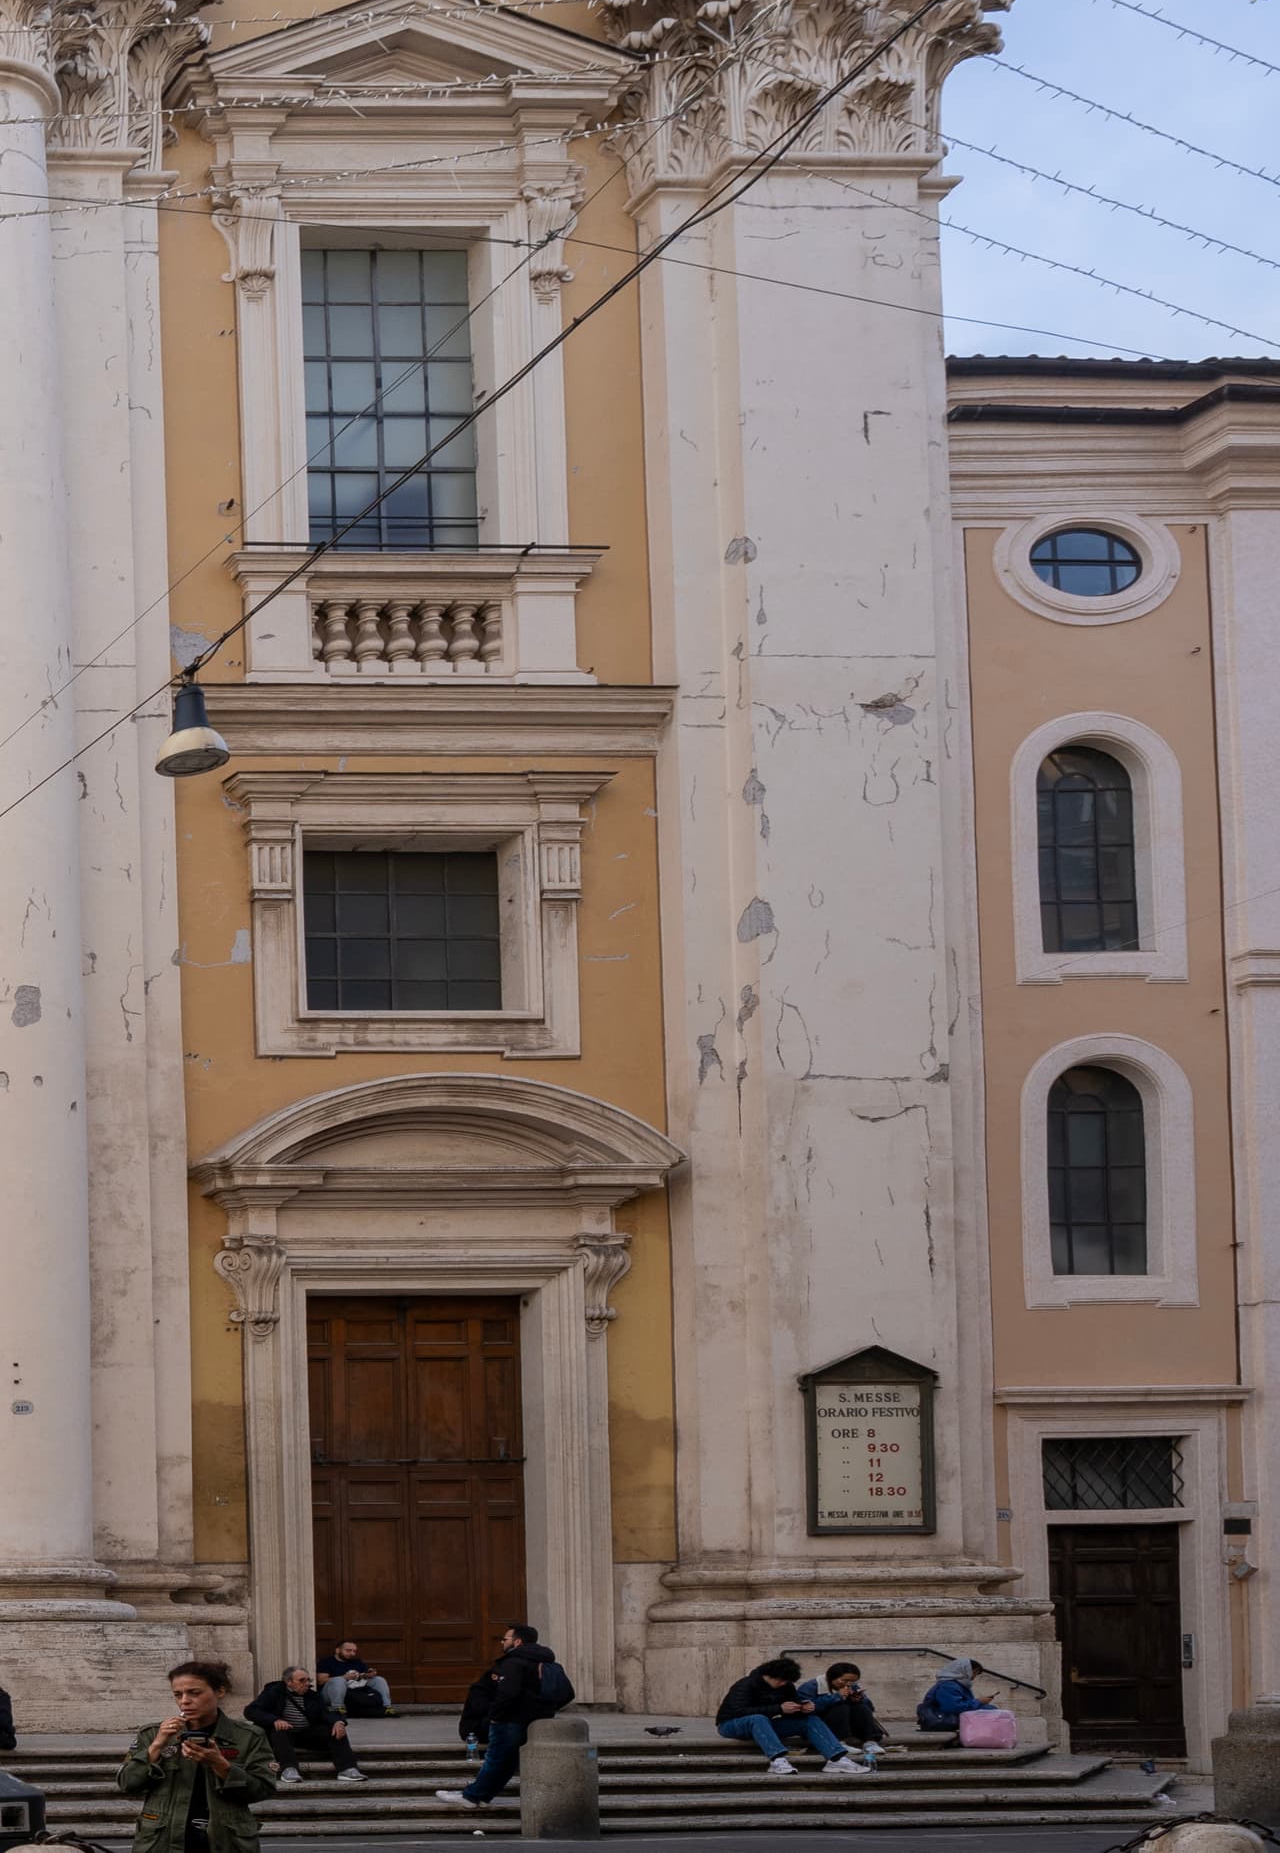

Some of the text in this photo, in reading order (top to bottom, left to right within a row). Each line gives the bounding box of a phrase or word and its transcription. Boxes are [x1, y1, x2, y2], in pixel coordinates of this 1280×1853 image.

[838, 1392, 901, 1403] S. MESSE
[817, 1407, 920, 1417] ORARIO FESTIVO
[831, 1428, 876, 1438] ORE 8
[869, 1458, 881, 1467] 11
[869, 1473, 884, 1482] 12
